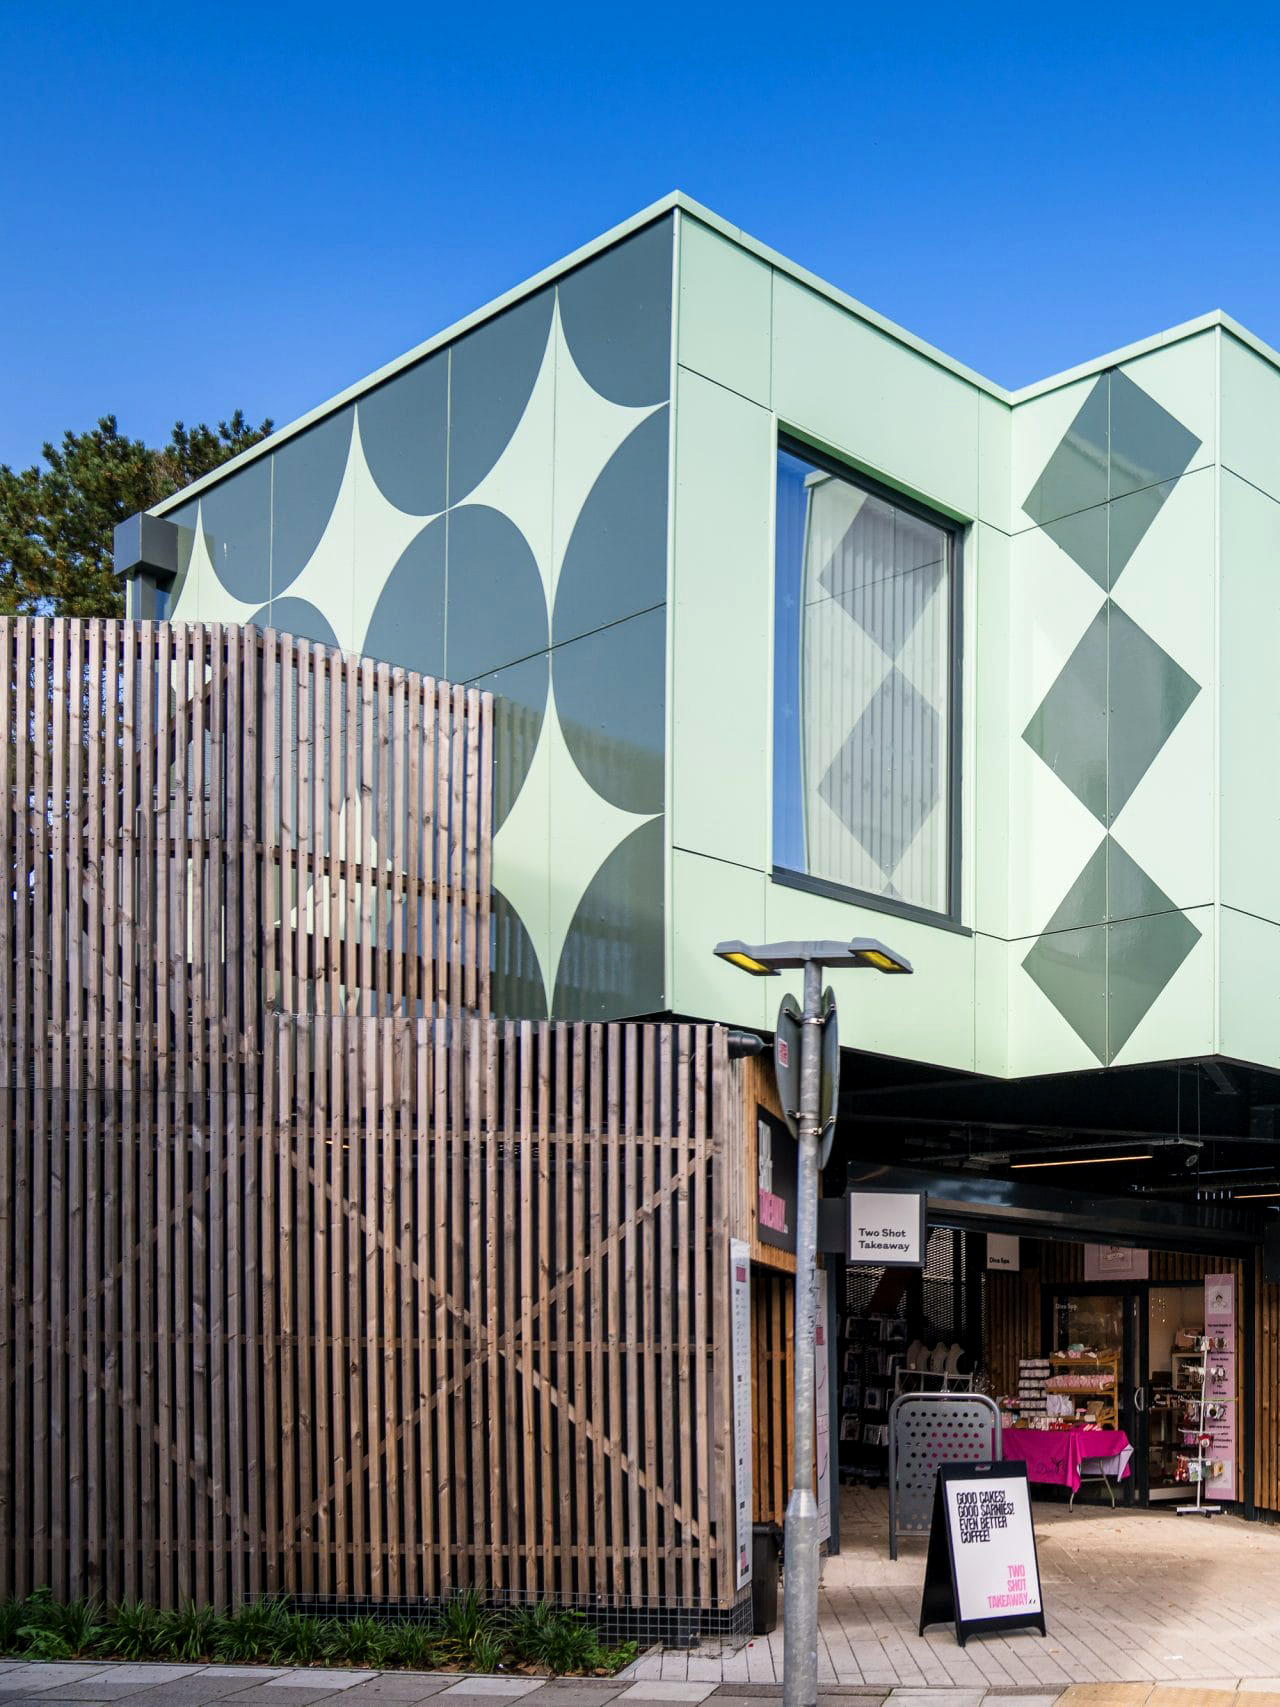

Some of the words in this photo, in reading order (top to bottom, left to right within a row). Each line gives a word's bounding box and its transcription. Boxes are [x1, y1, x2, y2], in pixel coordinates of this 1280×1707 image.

[858, 1228, 880, 1237] Two
[882, 1229, 906, 1238] Shot
[858, 1240, 910, 1252] Takeaway
[956, 1492, 978, 1505] GOOD
[979, 1490, 1006, 1503] CAKES!
[957, 1505, 979, 1517] GOOD
[960, 1518, 979, 1531] EVEN
[980, 1516, 1007, 1530] BETTER
[960, 1530, 991, 1543] COFFEE!
[1008, 1565, 1025, 1578] TWO
[1008, 1579, 1026, 1592] SHOT
